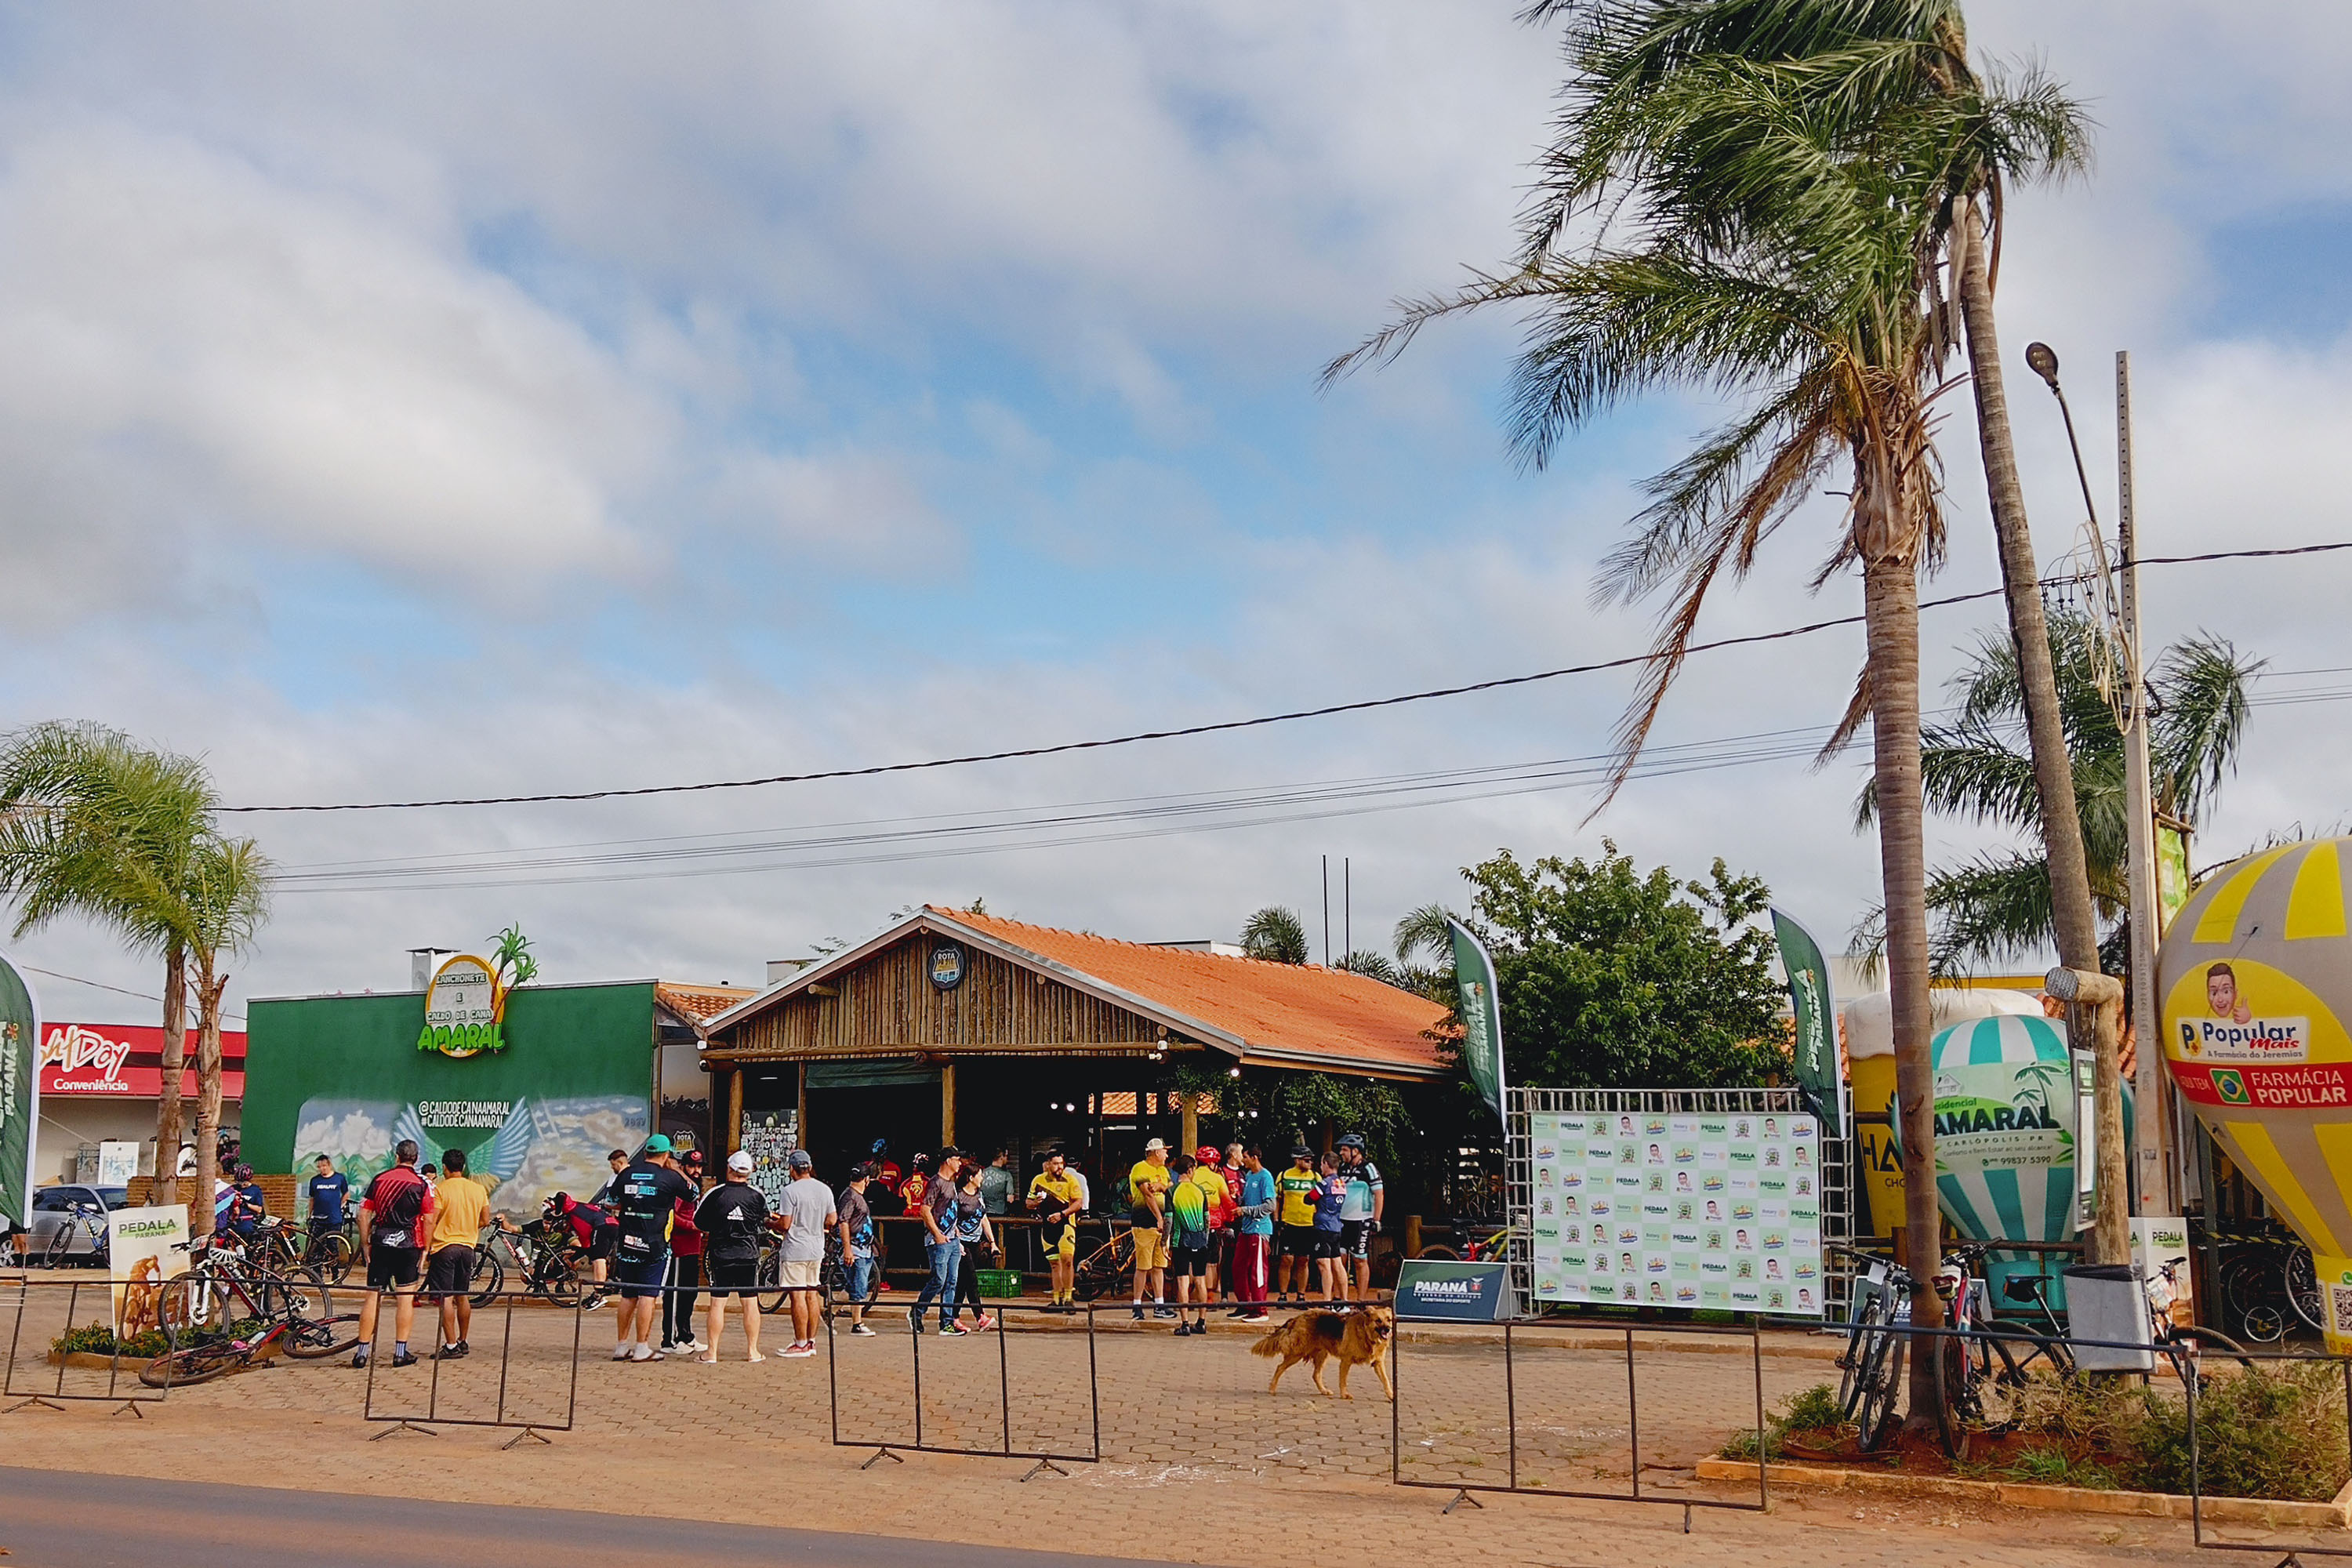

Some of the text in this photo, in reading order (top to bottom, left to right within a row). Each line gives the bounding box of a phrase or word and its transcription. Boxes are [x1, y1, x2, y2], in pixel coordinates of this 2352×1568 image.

[437, 974, 486, 984] LANCHONETE
[456, 993, 463, 1002] E
[426, 1009, 492, 1021] CALDO DE CANA
[417, 1022, 505, 1051] AMARAL
[2202, 1022, 2296, 1047] Popular
[2249, 1038, 2299, 1051] Mais
[53, 1078, 129, 1091] Conveniência
[2251, 1068, 2344, 1087] FARMÁCIA
[2256, 1087, 2347, 1105] POPULAR
[418, 1101, 510, 1116] @CALDODECANAAMARAL
[1934, 1098, 1976, 1110] esidencial
[421, 1114, 504, 1128] #CALDODECANAAMARAL
[1934, 1106, 2061, 1137] AMARAL
[1860, 1134, 1904, 1172] HA
[118, 1218, 176, 1235] PEDALA
[2152, 1232, 2183, 1242] PEDALA
[1414, 1280, 1468, 1293] PARANÁ
